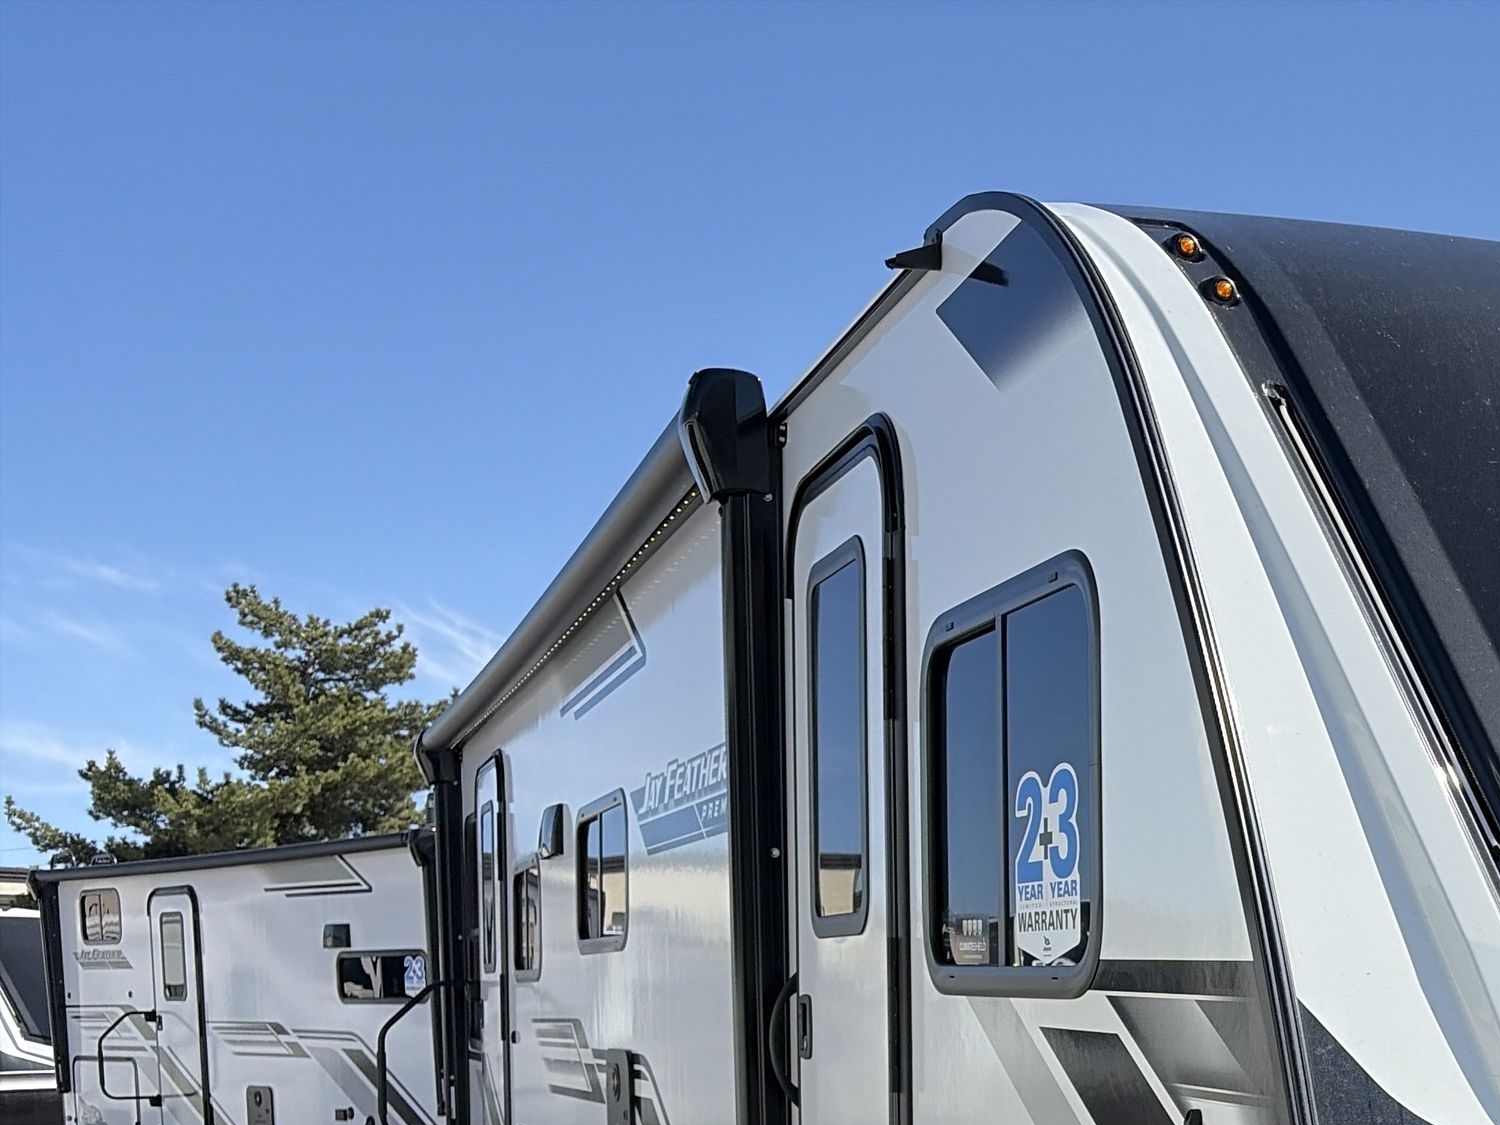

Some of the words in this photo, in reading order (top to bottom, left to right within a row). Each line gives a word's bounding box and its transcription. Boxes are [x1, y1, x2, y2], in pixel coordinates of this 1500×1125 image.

[638, 775, 664, 815] JAY
[1018, 884, 1044, 901] YEAR
[1049, 880, 1078, 899] YEAR
[1017, 908, 1079, 933] WARRANTY
